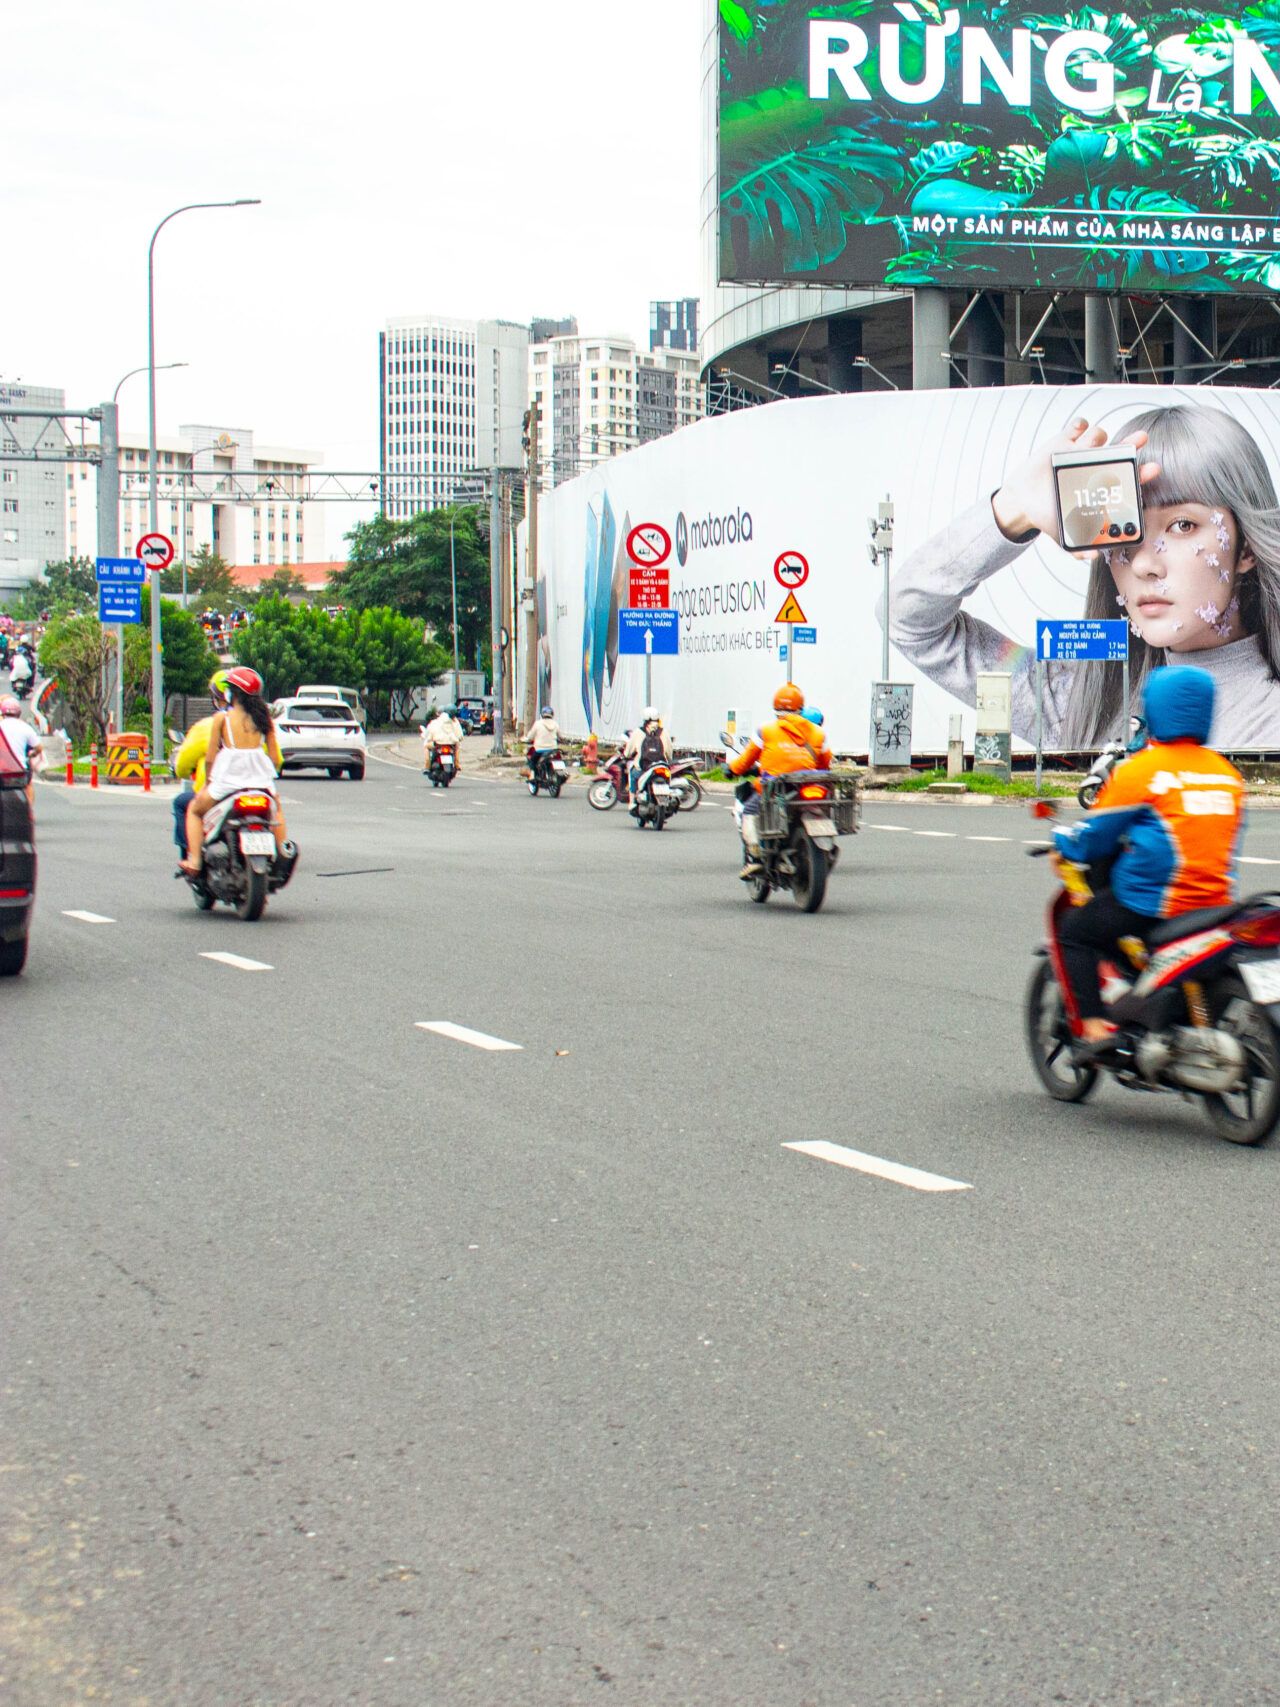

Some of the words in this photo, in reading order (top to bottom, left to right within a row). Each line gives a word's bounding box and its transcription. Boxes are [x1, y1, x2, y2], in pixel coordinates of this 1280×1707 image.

[809, 2, 1115, 111] RỪNG
[1147, 69, 1202, 113] Là
[913, 213, 958, 236] MỘT
[964, 214, 1004, 234] SẢN
[1011, 216, 1068, 236] PHẨM
[1076, 218, 1116, 238] CỦA
[1123, 221, 1164, 239] NHÀ
[1171, 221, 1224, 241] SÁNG
[1231, 223, 1265, 245] LẬP
[1074, 485, 1123, 508] 11:35
[691, 506, 753, 550] motorola
[699, 586, 712, 616] 60
[714, 580, 766, 614] FUSION
[729, 628, 753, 650] KHÁC
[755, 626, 781, 653] BIỆT
[1117, 651, 1126, 659] km
